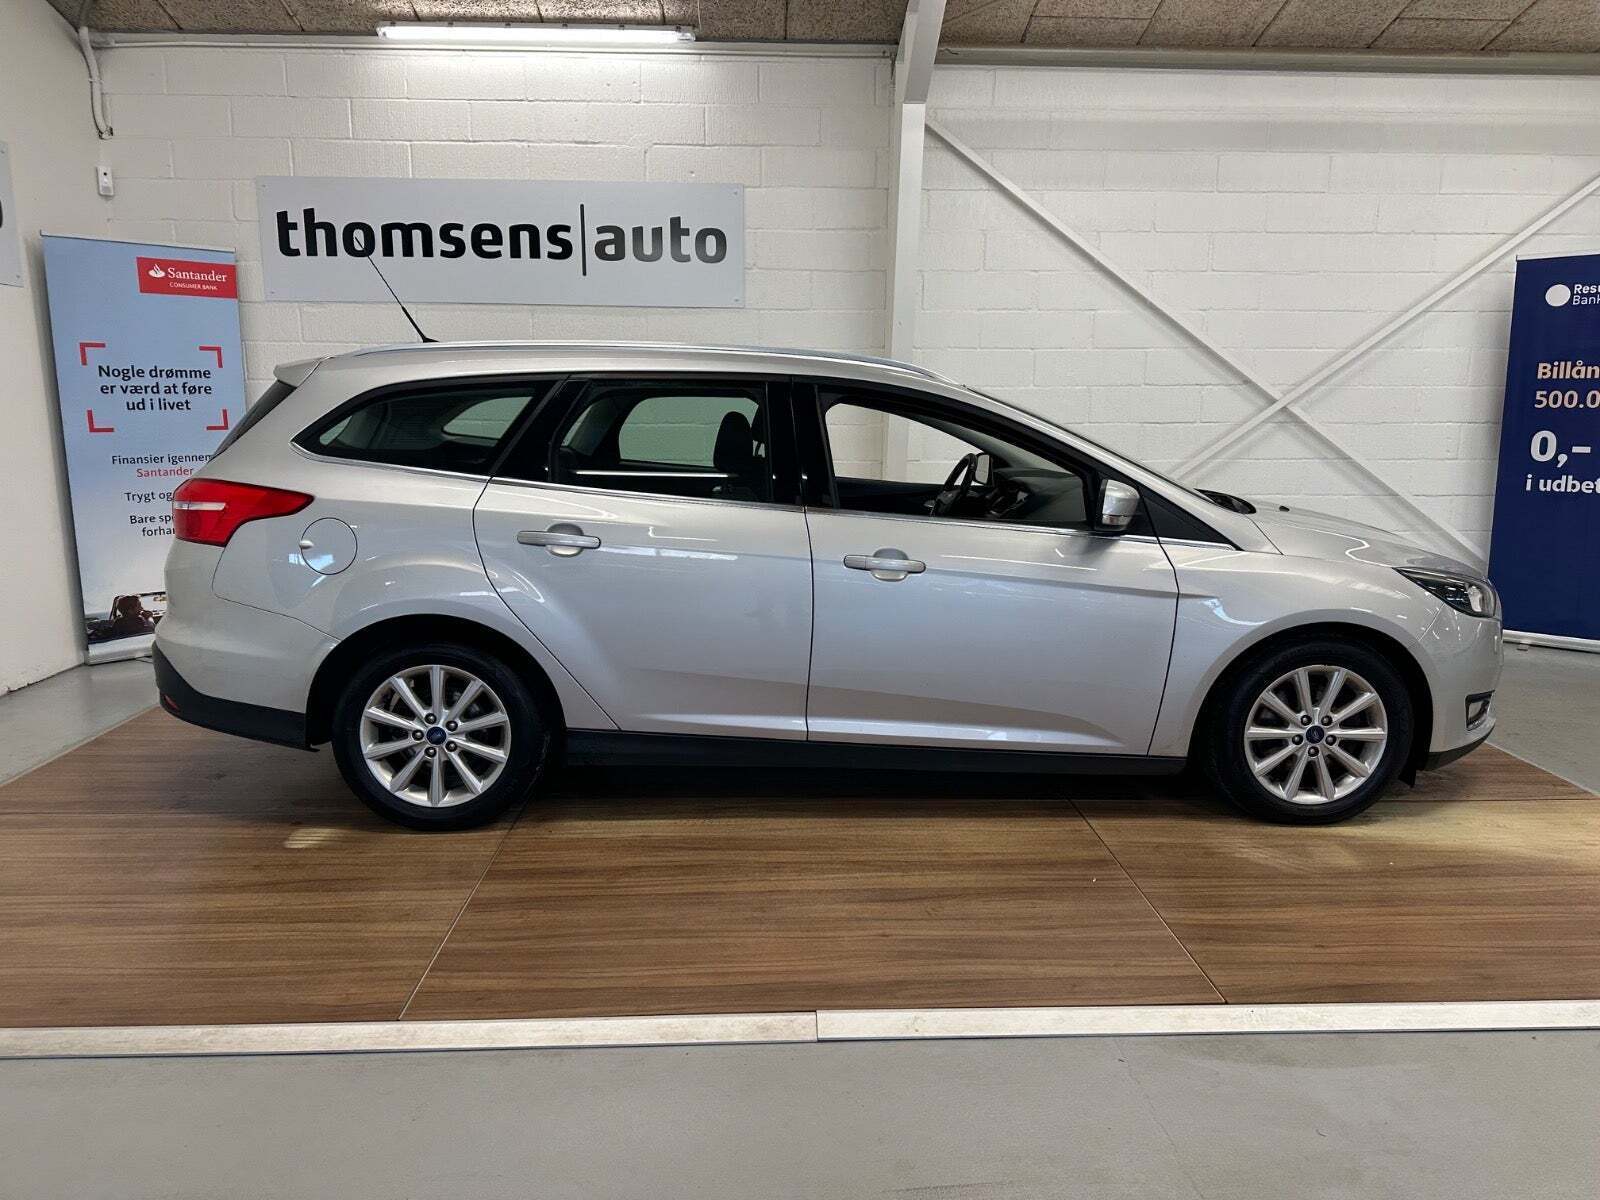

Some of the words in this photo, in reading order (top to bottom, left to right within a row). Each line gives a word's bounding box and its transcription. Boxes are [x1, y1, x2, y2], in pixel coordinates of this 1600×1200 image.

[276, 207, 574, 260] thomsens
[594, 215, 727, 264] auto
[167, 267, 228, 282] Santander
[1574, 284, 1600, 294] Res
[98, 365, 145, 382] Nogle
[149, 365, 211, 379] drømme
[1537, 360, 1600, 379] Billån
[100, 384, 116, 394] er
[120, 382, 160, 394] værd
[164, 384, 178, 394] at
[182, 382, 212, 395] føre
[126, 399, 145, 411] ud
[150, 399, 154, 411] i
[159, 398, 191, 411] livet
[1534, 390, 1600, 409] 500.0
[111, 455, 165, 465] Finansier
[136, 467, 194, 478] Santander
[1525, 474, 1532, 491] i
[124, 491, 156, 503] Trygt
[158, 492, 173, 502] og
[130, 515, 156, 524] Bare
[159, 515, 174, 524] sp
